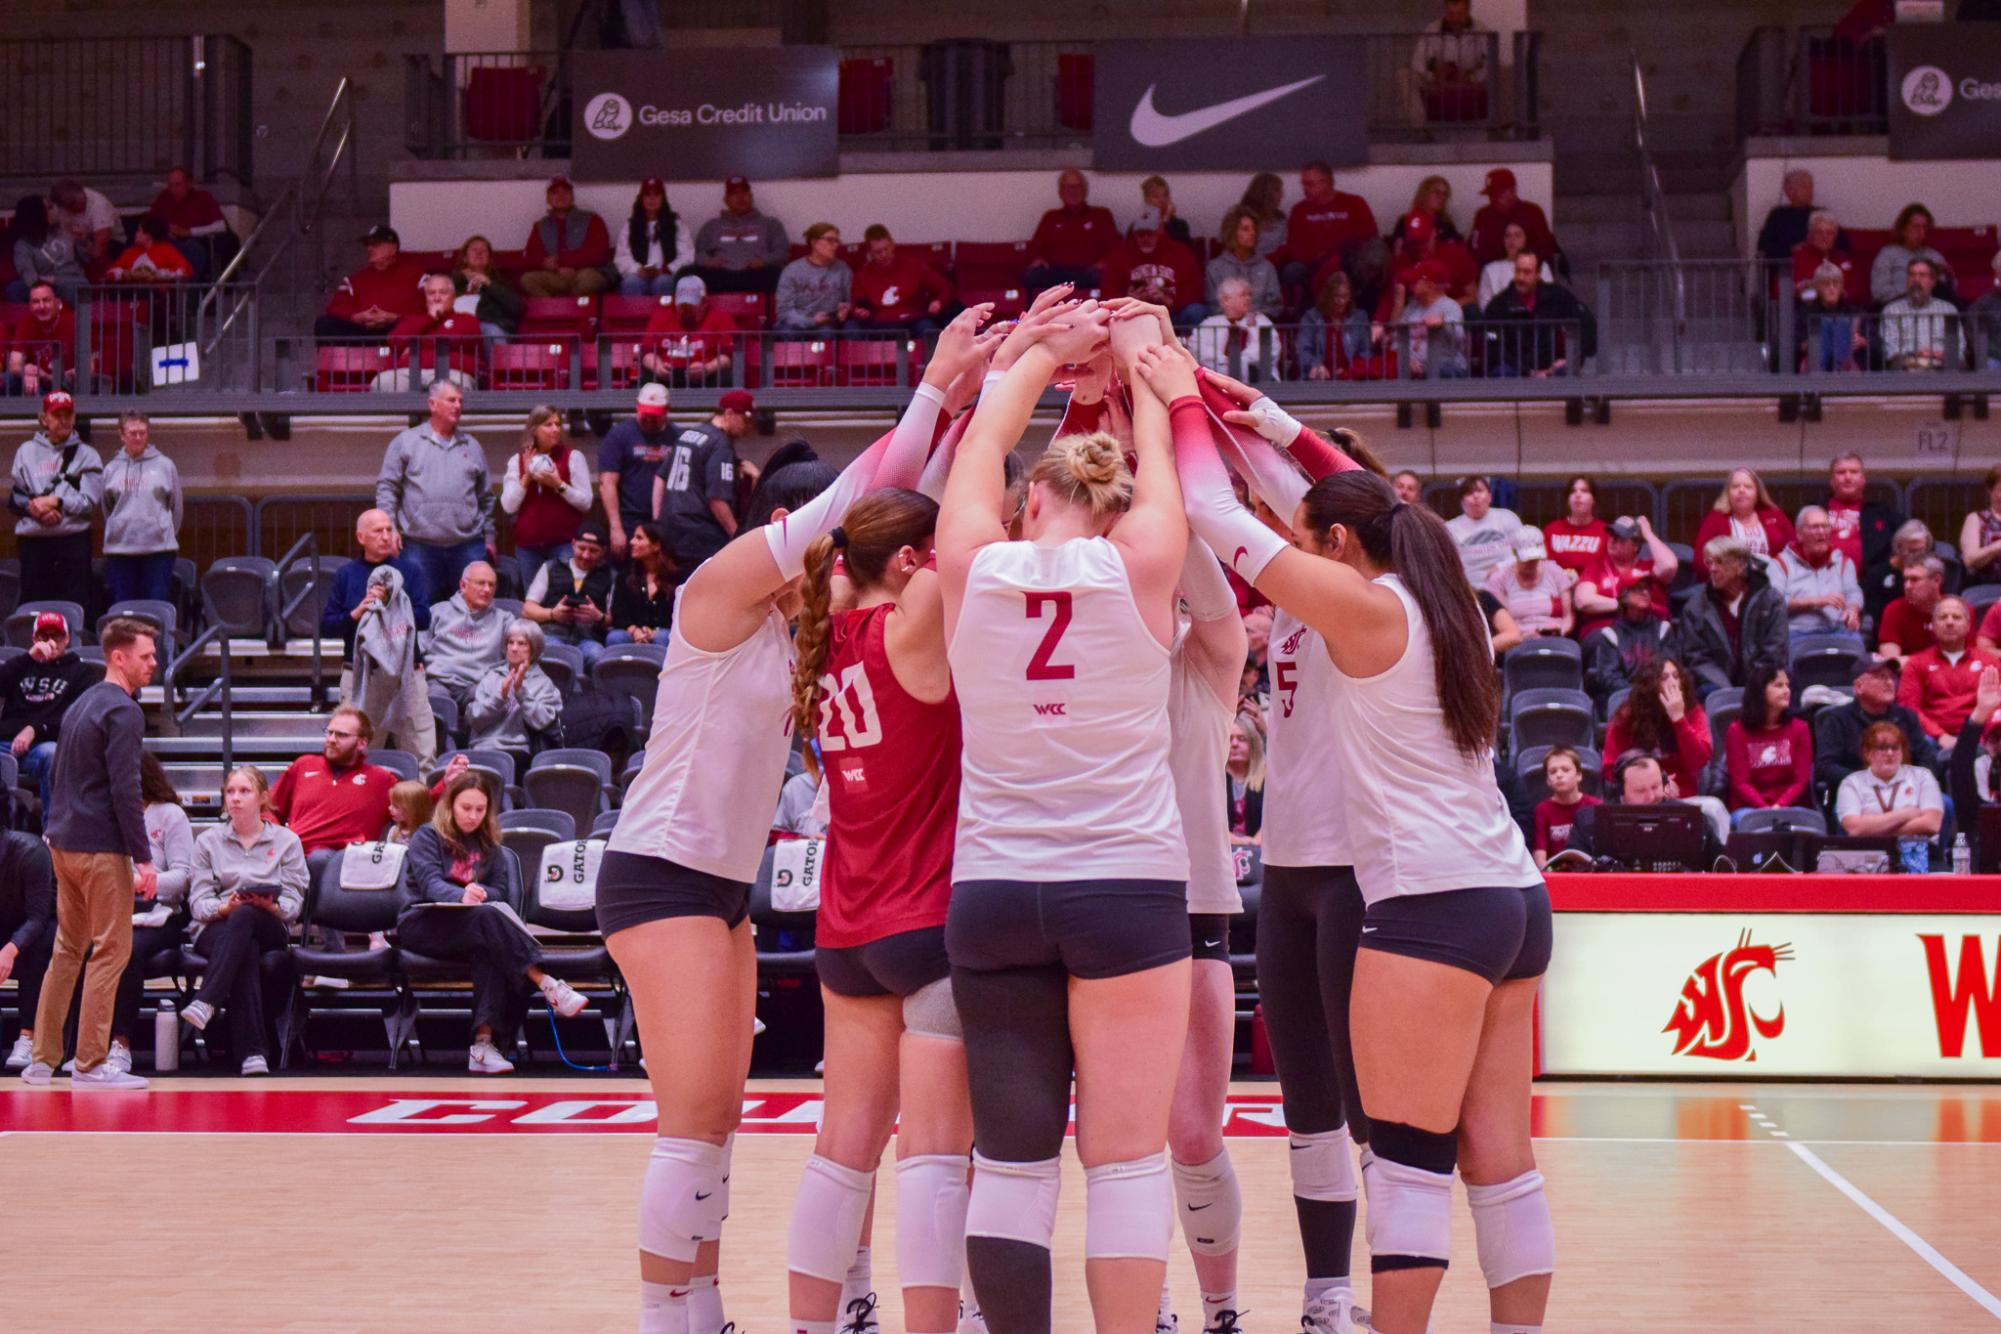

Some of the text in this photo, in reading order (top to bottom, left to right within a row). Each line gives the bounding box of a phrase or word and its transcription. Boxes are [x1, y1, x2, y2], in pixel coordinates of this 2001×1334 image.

[638, 101, 827, 125] Gesa Credit Union
[1918, 430, 1949, 451] FL2
[666, 445, 693, 492] 16
[721, 462, 734, 481] 16
[1551, 533, 1601, 554] WAZZU
[1019, 589, 1075, 681] 2
[19, 676, 69, 696] WSU
[1275, 661, 1299, 719] 5
[816, 660, 883, 752] 20
[1032, 702, 1067, 716] WCC
[841, 767, 866, 782] WCC
